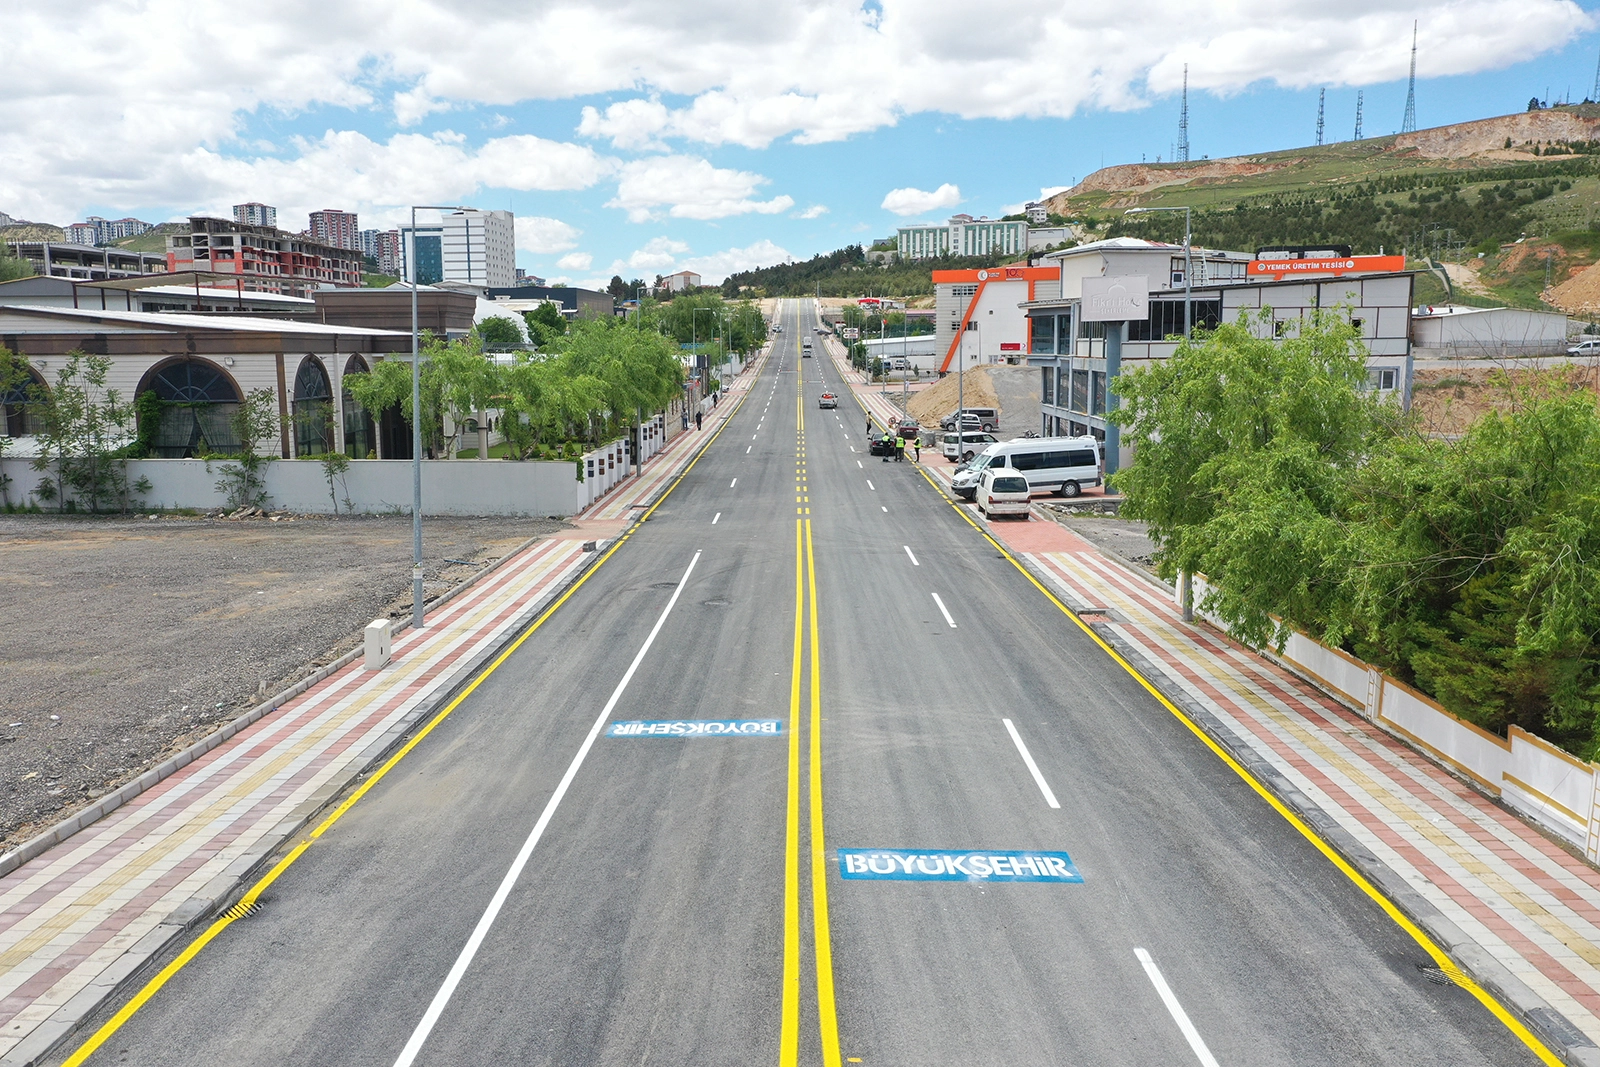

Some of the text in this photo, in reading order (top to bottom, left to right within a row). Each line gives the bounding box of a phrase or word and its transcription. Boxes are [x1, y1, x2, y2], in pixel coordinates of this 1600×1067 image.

[1266, 261, 1346, 271] YEMEK ÜRETİM TESİSİ
[613, 722, 777, 736] BÜYÜKŞEHİR
[845, 854, 1074, 878] BÜYÜKŞEHİR
